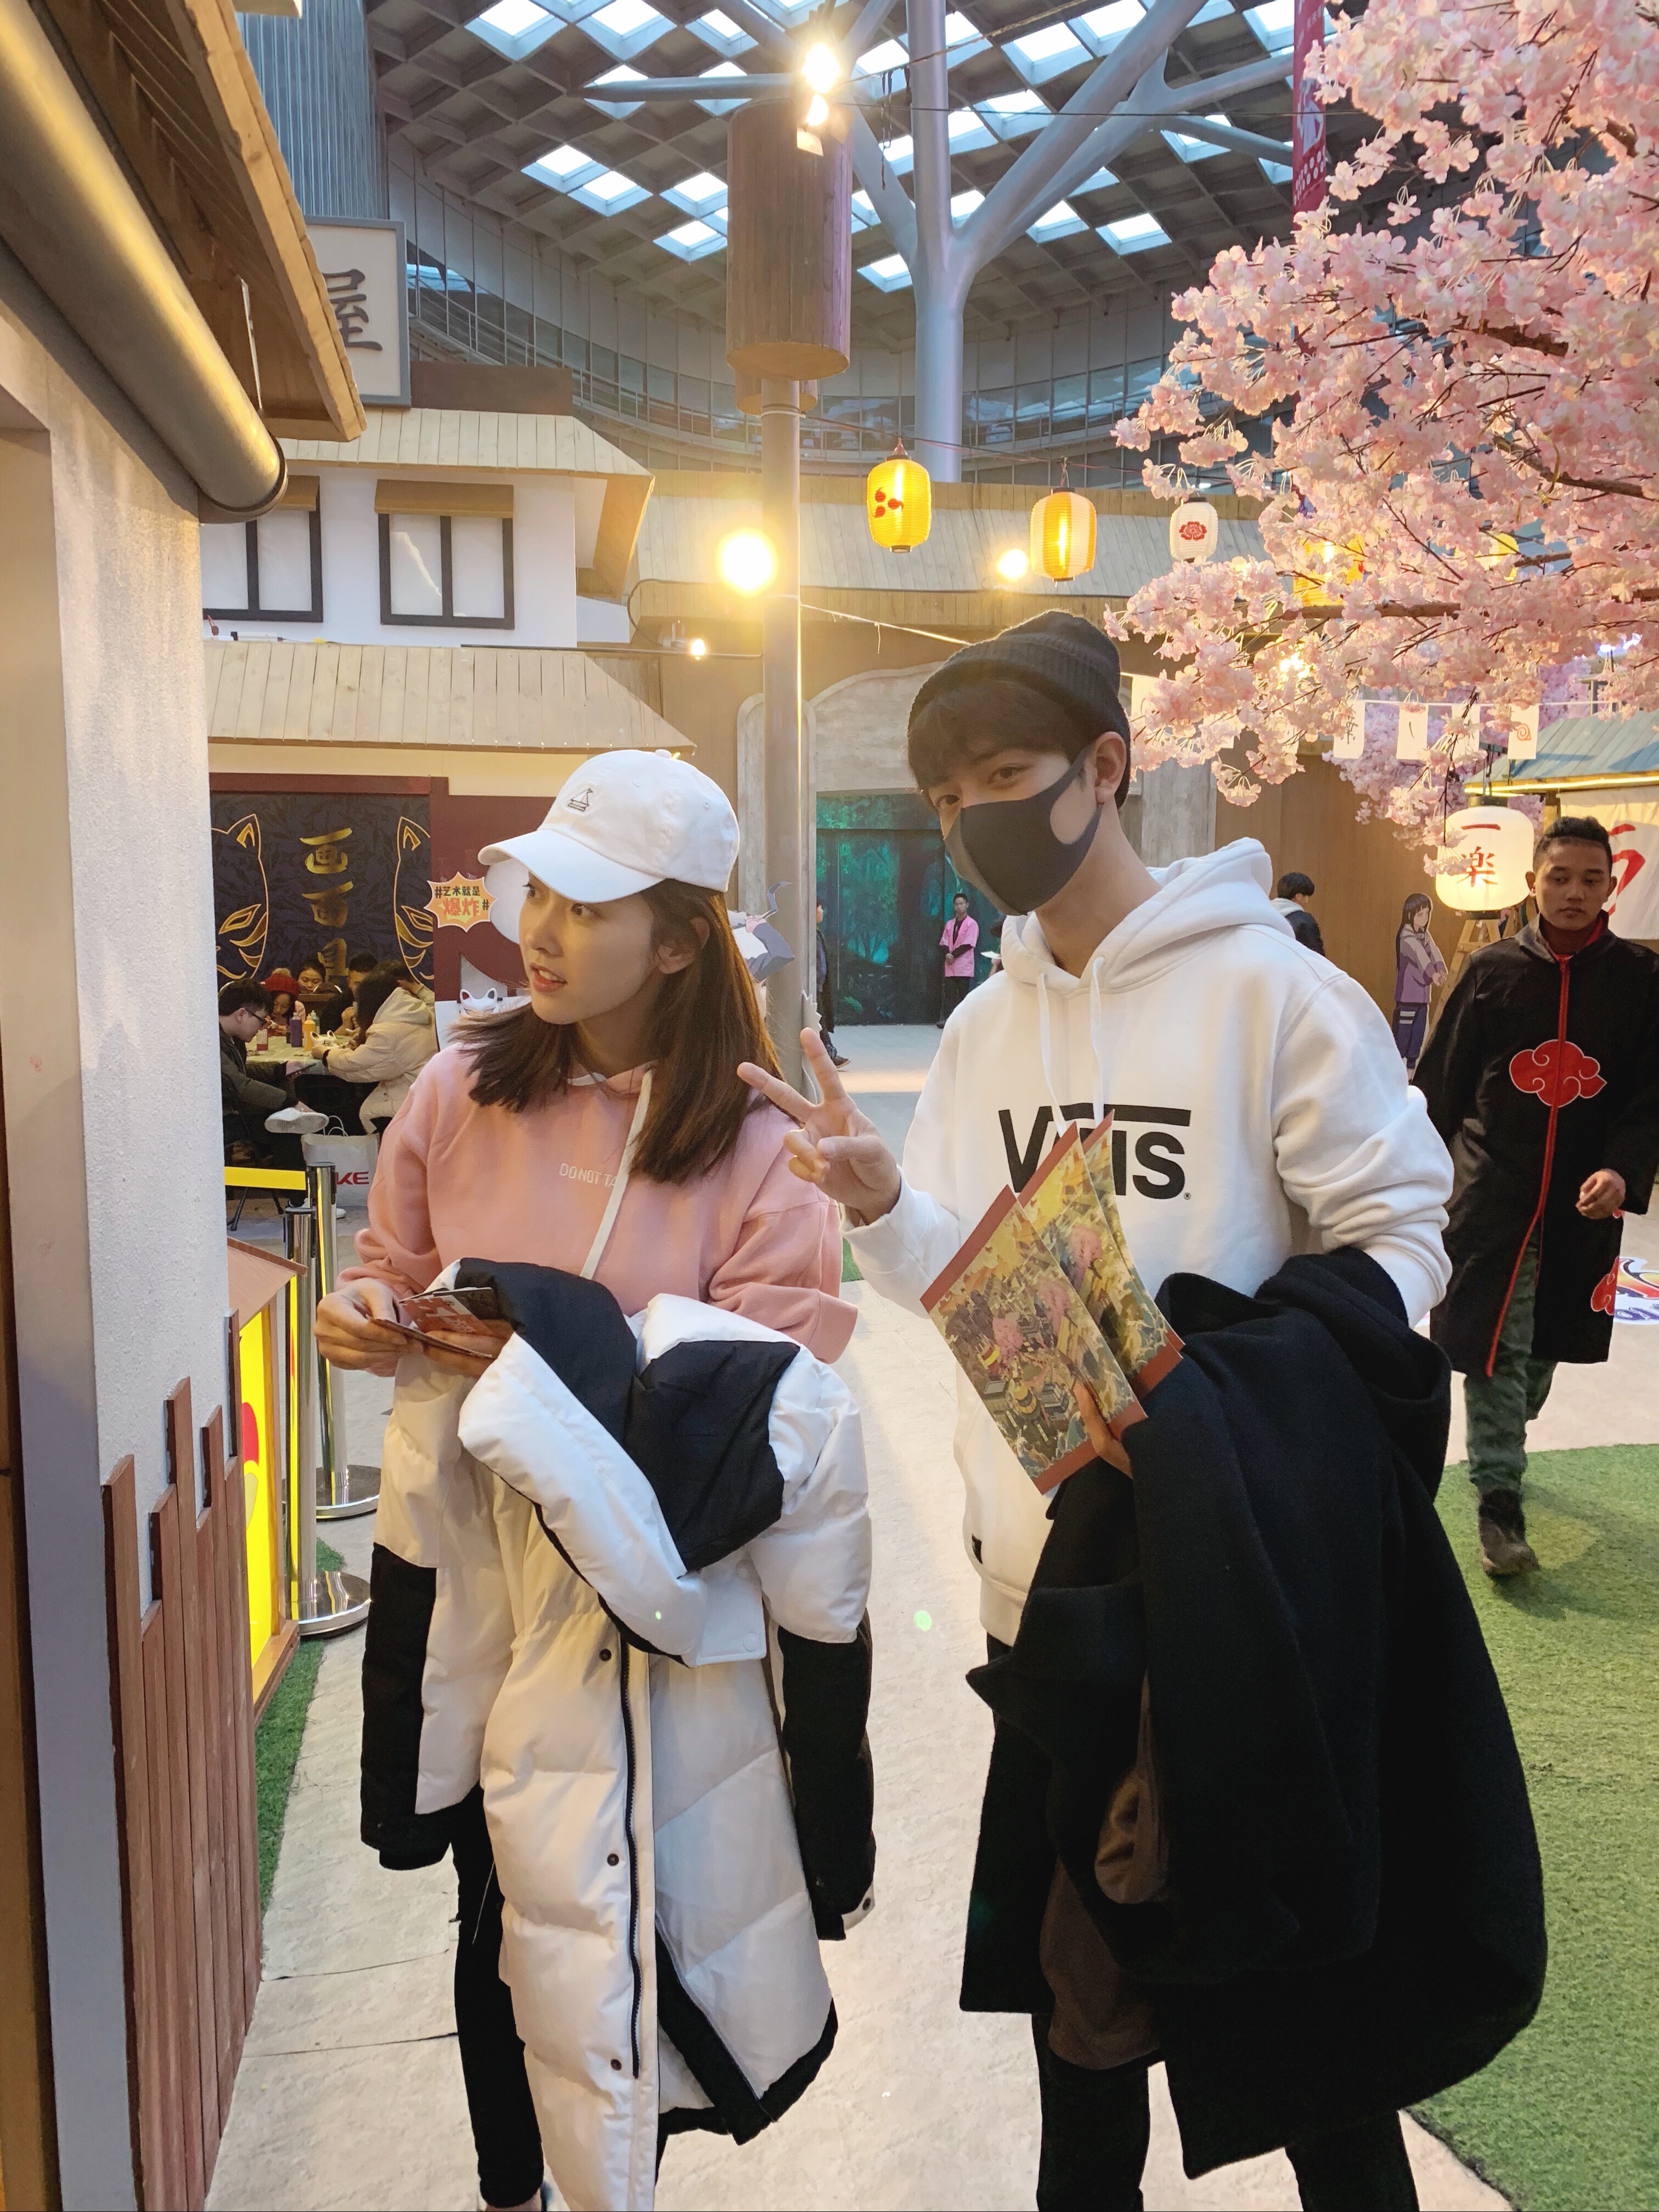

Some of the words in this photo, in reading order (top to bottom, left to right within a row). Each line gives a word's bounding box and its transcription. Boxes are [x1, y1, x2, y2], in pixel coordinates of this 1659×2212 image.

[435, 885, 481, 899] #艺术就是
[998, 1102, 1192, 1200] VS
[334, 1171, 370, 1185] KE
[560, 1164, 577, 1178] DO
[579, 1169, 602, 1184] NOT
